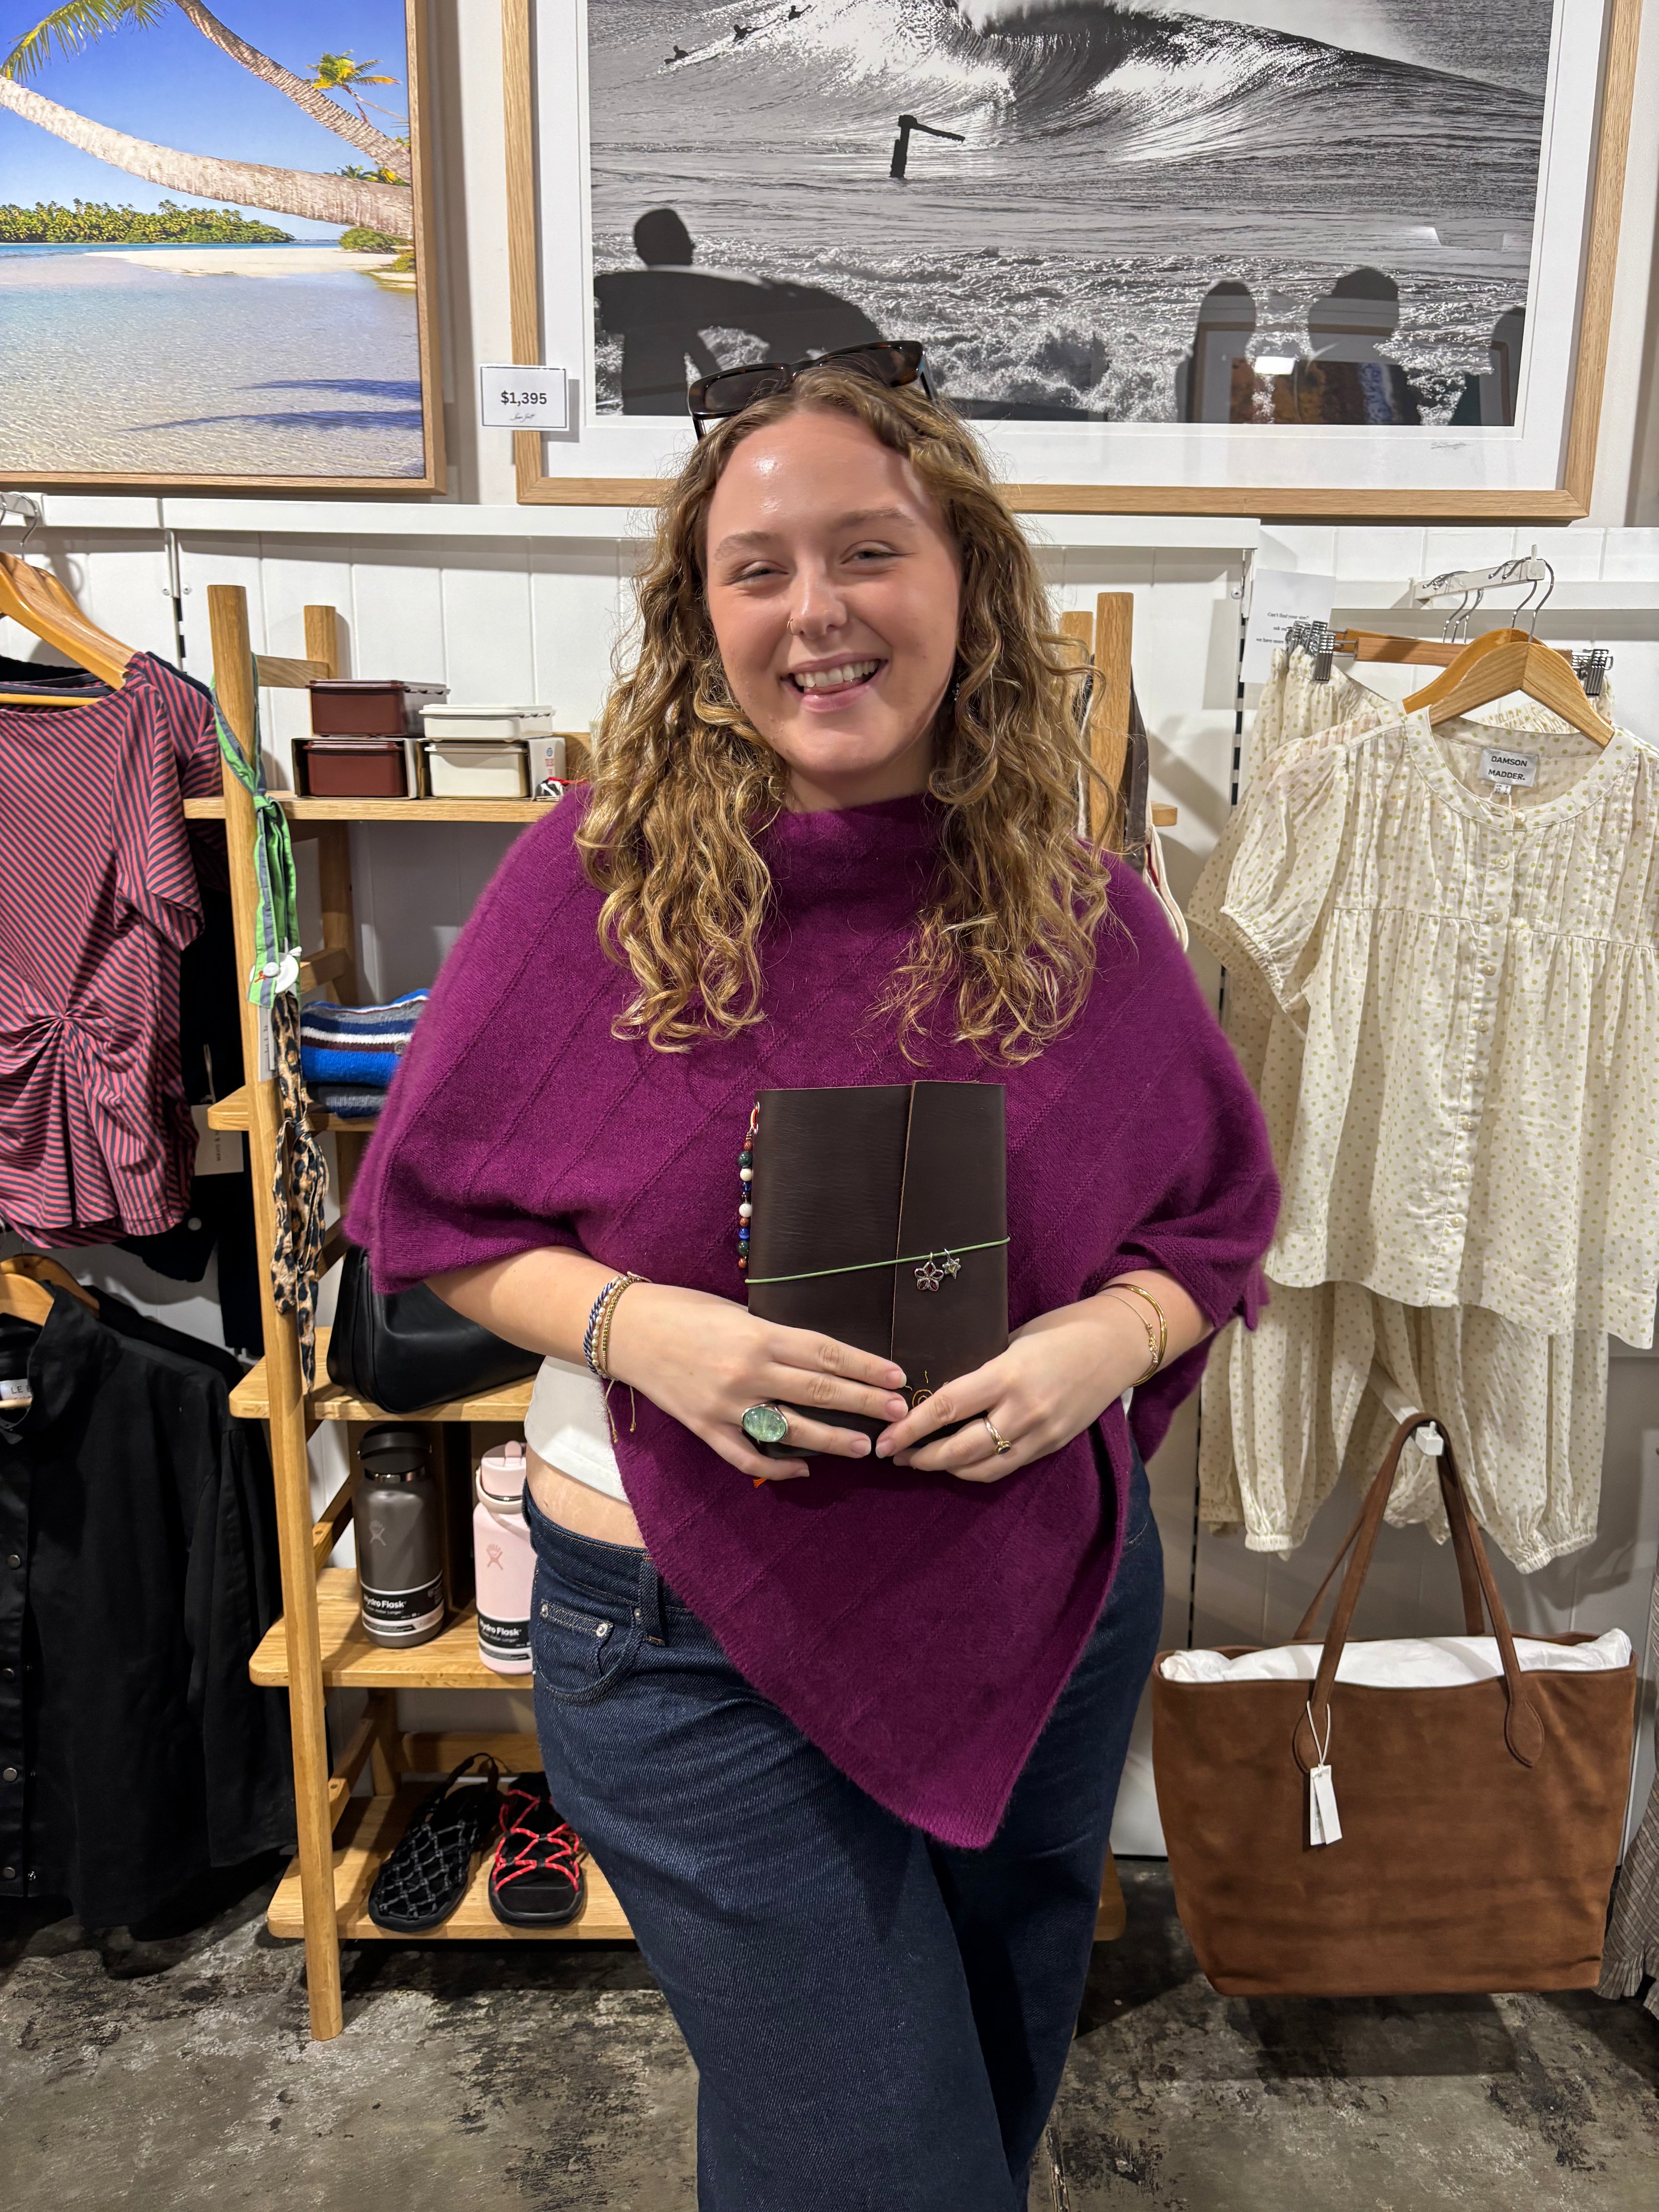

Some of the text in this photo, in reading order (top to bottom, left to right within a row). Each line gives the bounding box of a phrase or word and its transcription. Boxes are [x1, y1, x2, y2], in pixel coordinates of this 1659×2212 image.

[501, 390, 547, 406] $1,395
[1491, 756, 1528, 767] DAMSON
[1488, 769, 1526, 780] MADDER.
[11, 1386, 23, 1394] LE
[381, 1600, 404, 1608] Flask
